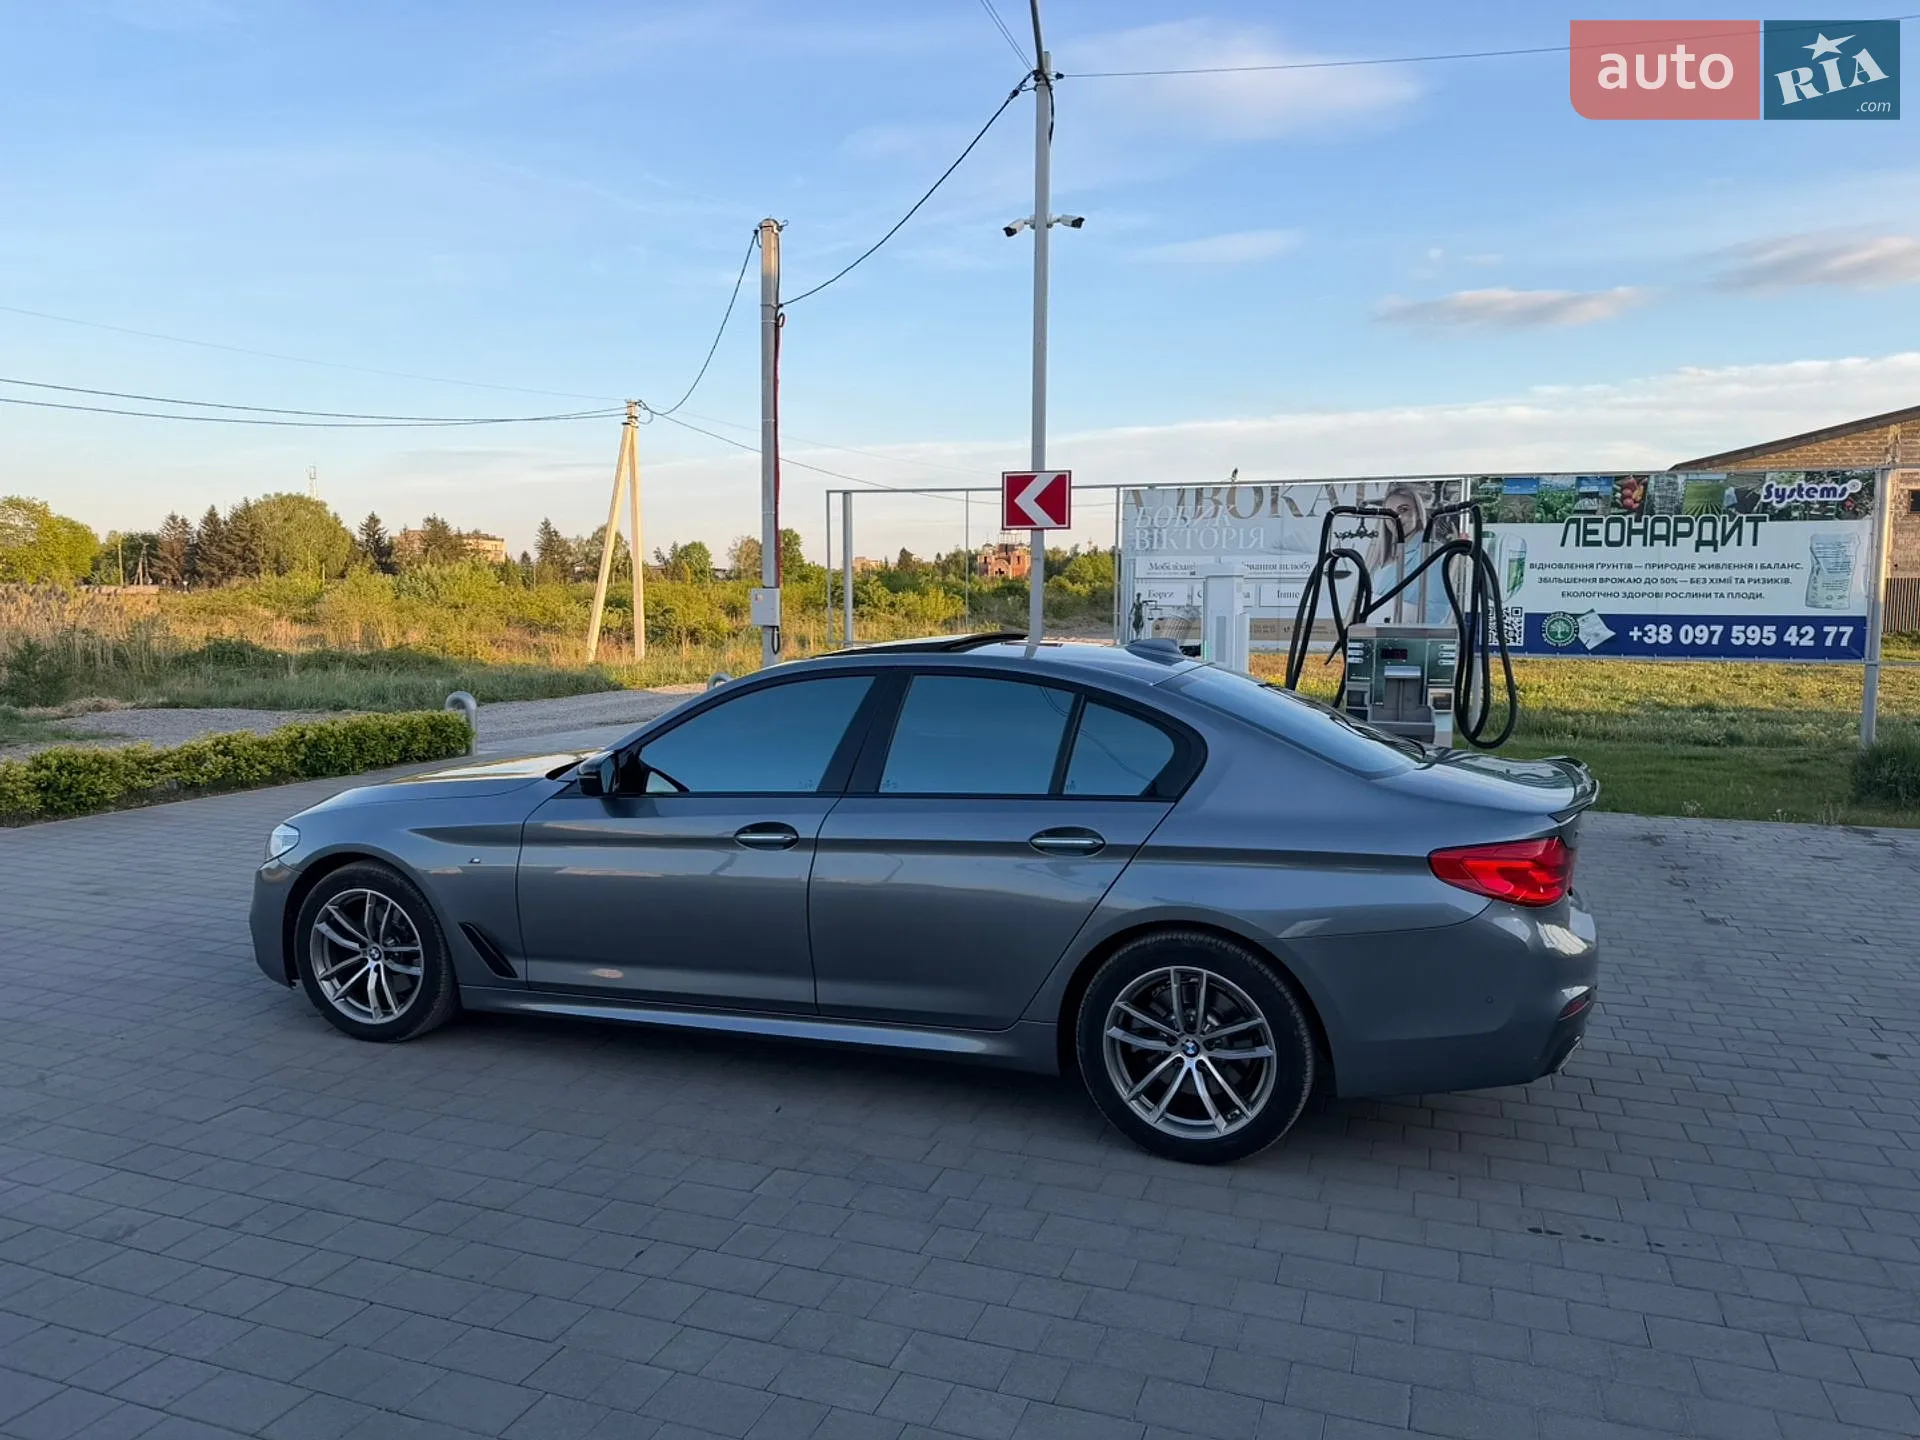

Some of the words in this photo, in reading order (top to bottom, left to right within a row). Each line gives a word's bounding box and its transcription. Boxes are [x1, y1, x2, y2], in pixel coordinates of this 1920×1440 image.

[1762, 481, 1849, 505] Systems
[1135, 527, 1265, 550] ВІКТОРІЯ
[1560, 515, 1768, 553] ЛЕОНАРДИТ
[1529, 562, 1596, 570] ВІДНОВЛЕННЯ
[1645, 562, 1698, 571] ПРИРОДНЕ
[1643, 577, 1659, 585] ДО
[1708, 577, 1732, 585] ХІМІЇ
[1621, 591, 1663, 599] ЗДОРОВІ
[1665, 591, 1712, 599] РОСЛИНИ
[1727, 592, 1765, 600] ПЛОДИ.
[1629, 624, 1673, 645] +38
[1679, 624, 1724, 645] 097
[1730, 625, 1777, 646] 595
[1783, 625, 1815, 647] 42
[1823, 626, 1854, 647] 77
